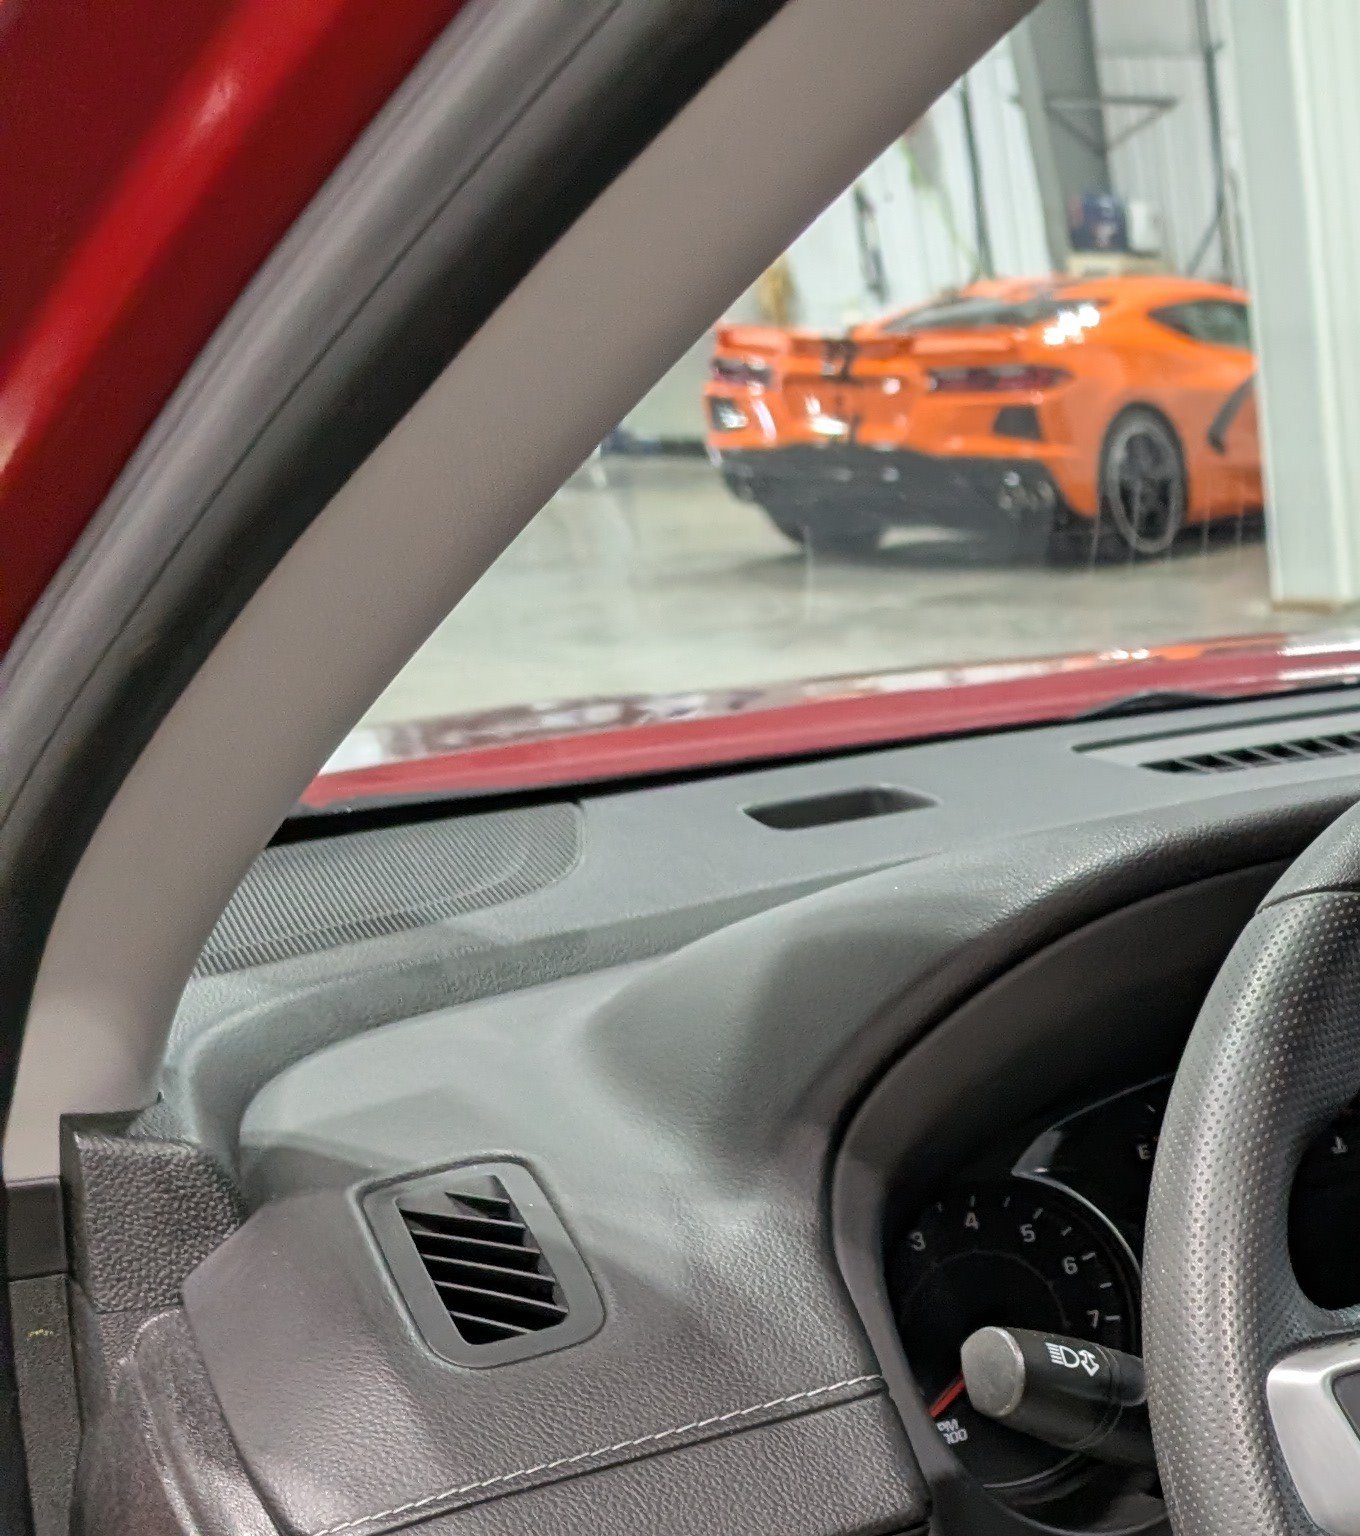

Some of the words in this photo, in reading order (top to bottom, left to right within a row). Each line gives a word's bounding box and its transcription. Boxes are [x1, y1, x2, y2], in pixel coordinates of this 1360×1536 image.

[964, 1212, 979, 1231] 4
[908, 1231, 926, 1251] 3
[1019, 1223, 1036, 1243] 5
[1063, 1256, 1079, 1275] 6
[1086, 1309, 1100, 1329] 7
